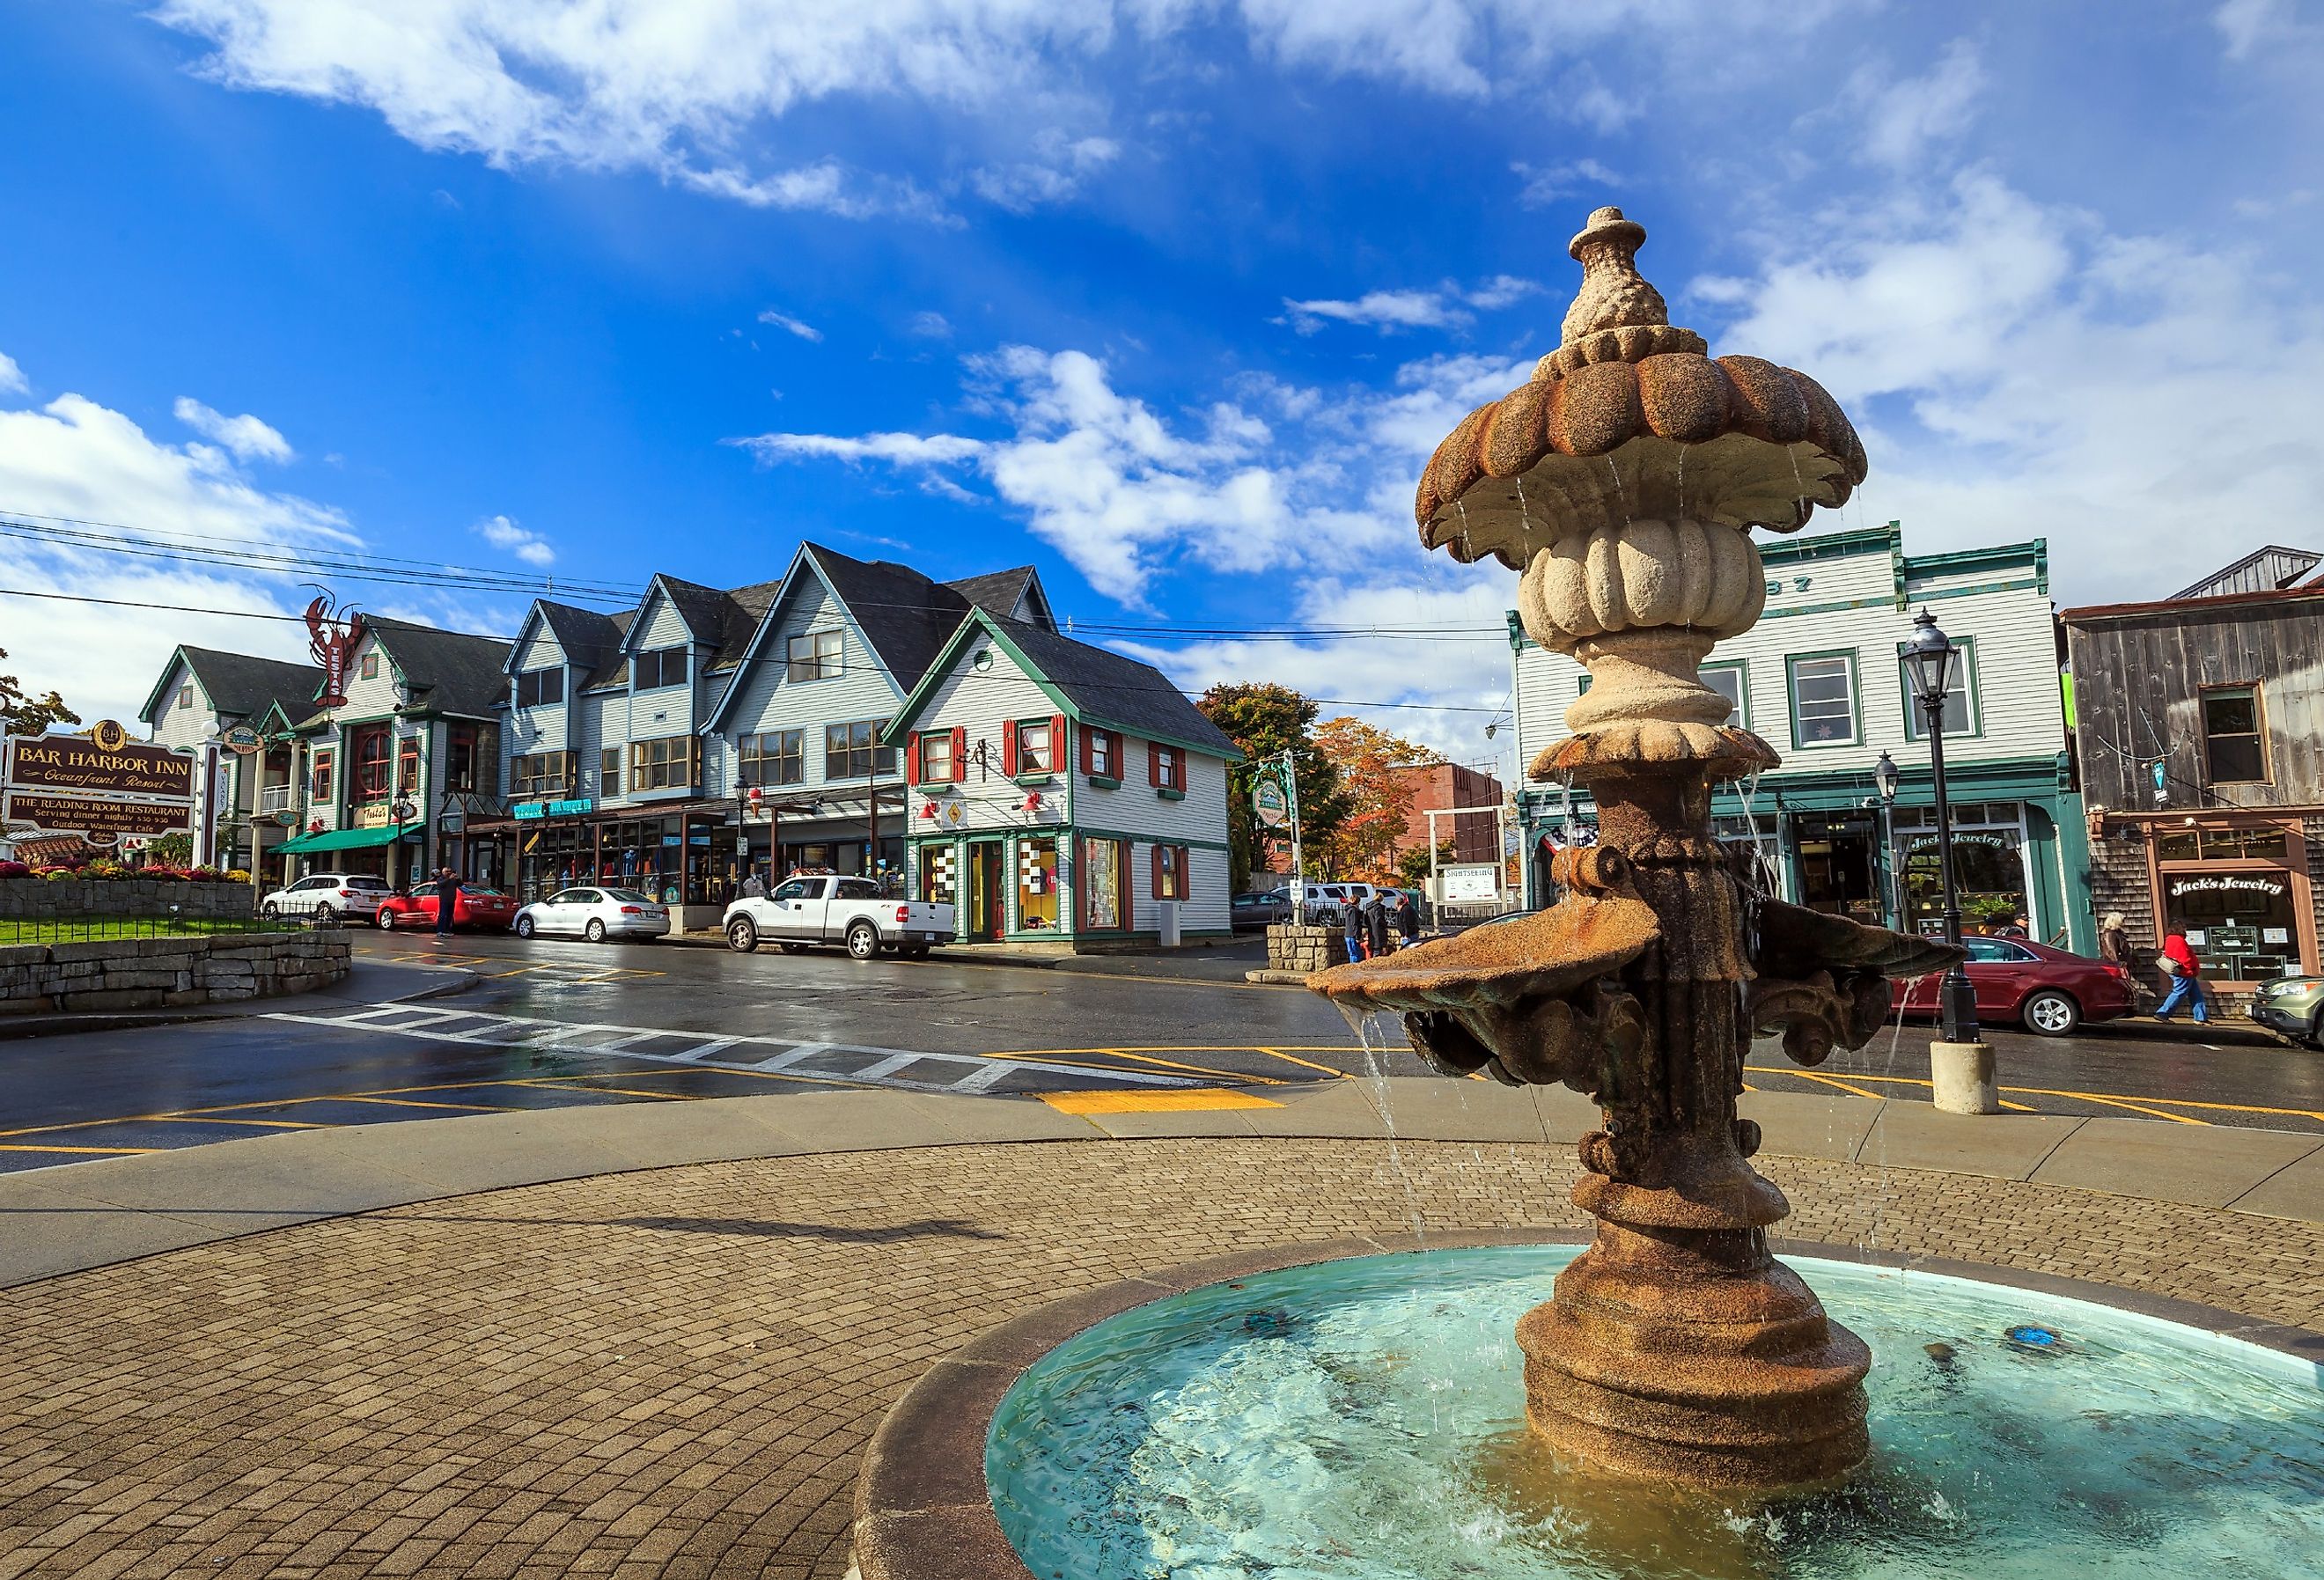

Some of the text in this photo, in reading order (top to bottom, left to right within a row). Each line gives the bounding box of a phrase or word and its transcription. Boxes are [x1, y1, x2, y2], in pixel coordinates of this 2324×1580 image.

[19, 746, 188, 775] BAR HARBOR INN
[44, 768, 165, 789] Oceanfront Resort
[14, 797, 187, 817] THE READING ROOM RESTAURANT
[35, 808, 70, 819] Serving
[73, 810, 100, 819] dinner
[105, 812, 134, 822] nightly
[52, 819, 86, 829] Outdoor
[90, 822, 133, 832] Waterfront
[1951, 833, 2004, 849] Jewelry
[1446, 868, 1493, 878] SIGHTSEEING
[2171, 877, 2284, 896] Jack's Jewelry
